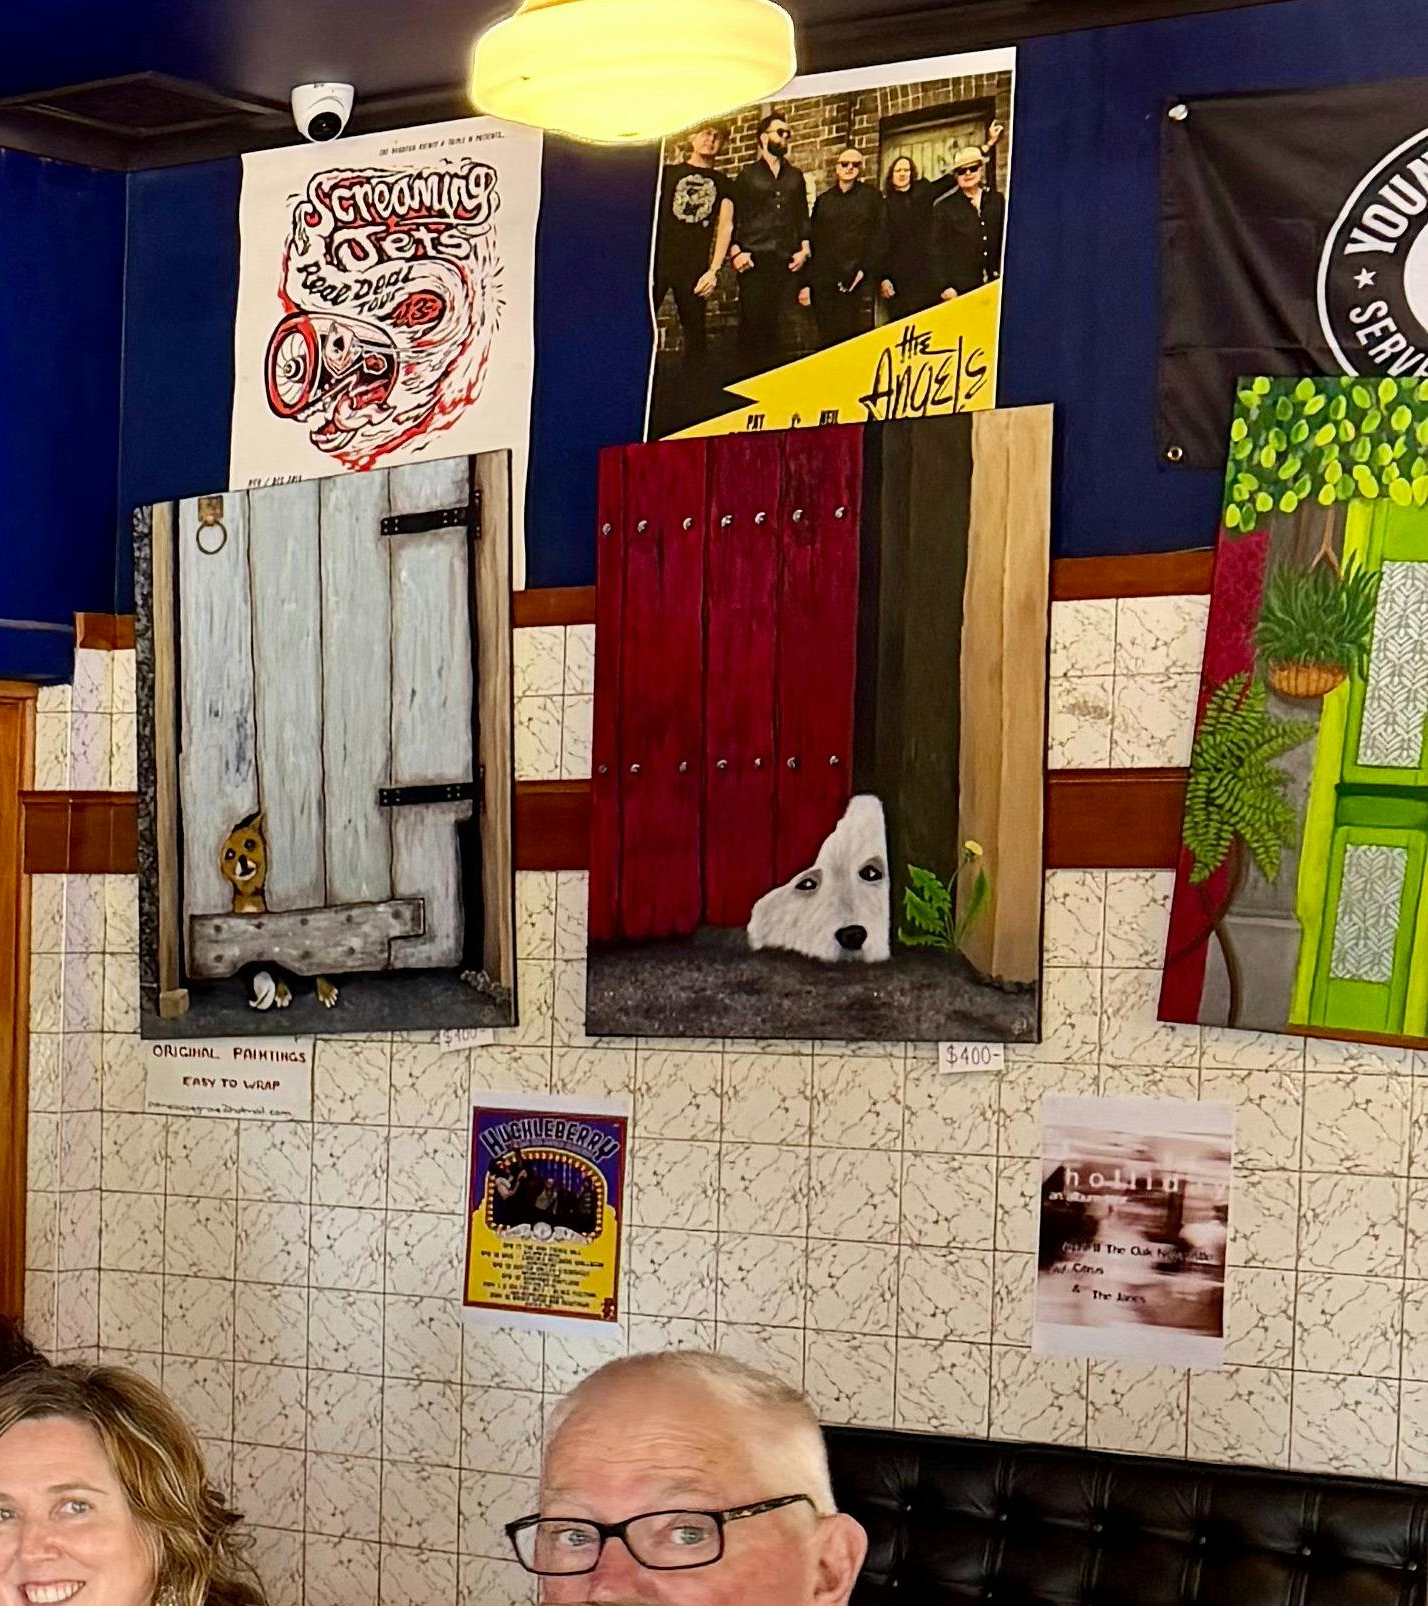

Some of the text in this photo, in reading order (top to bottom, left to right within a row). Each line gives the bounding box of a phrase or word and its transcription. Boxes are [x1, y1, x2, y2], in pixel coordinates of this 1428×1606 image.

[303, 165, 496, 237] Screaming
[334, 224, 473, 272] Jets
[296, 261, 415, 306] Real Deal
[152, 1044, 307, 1063] ORIGINAL PAINTINGS
[182, 1076, 281, 1090] EASY TO WRAP
